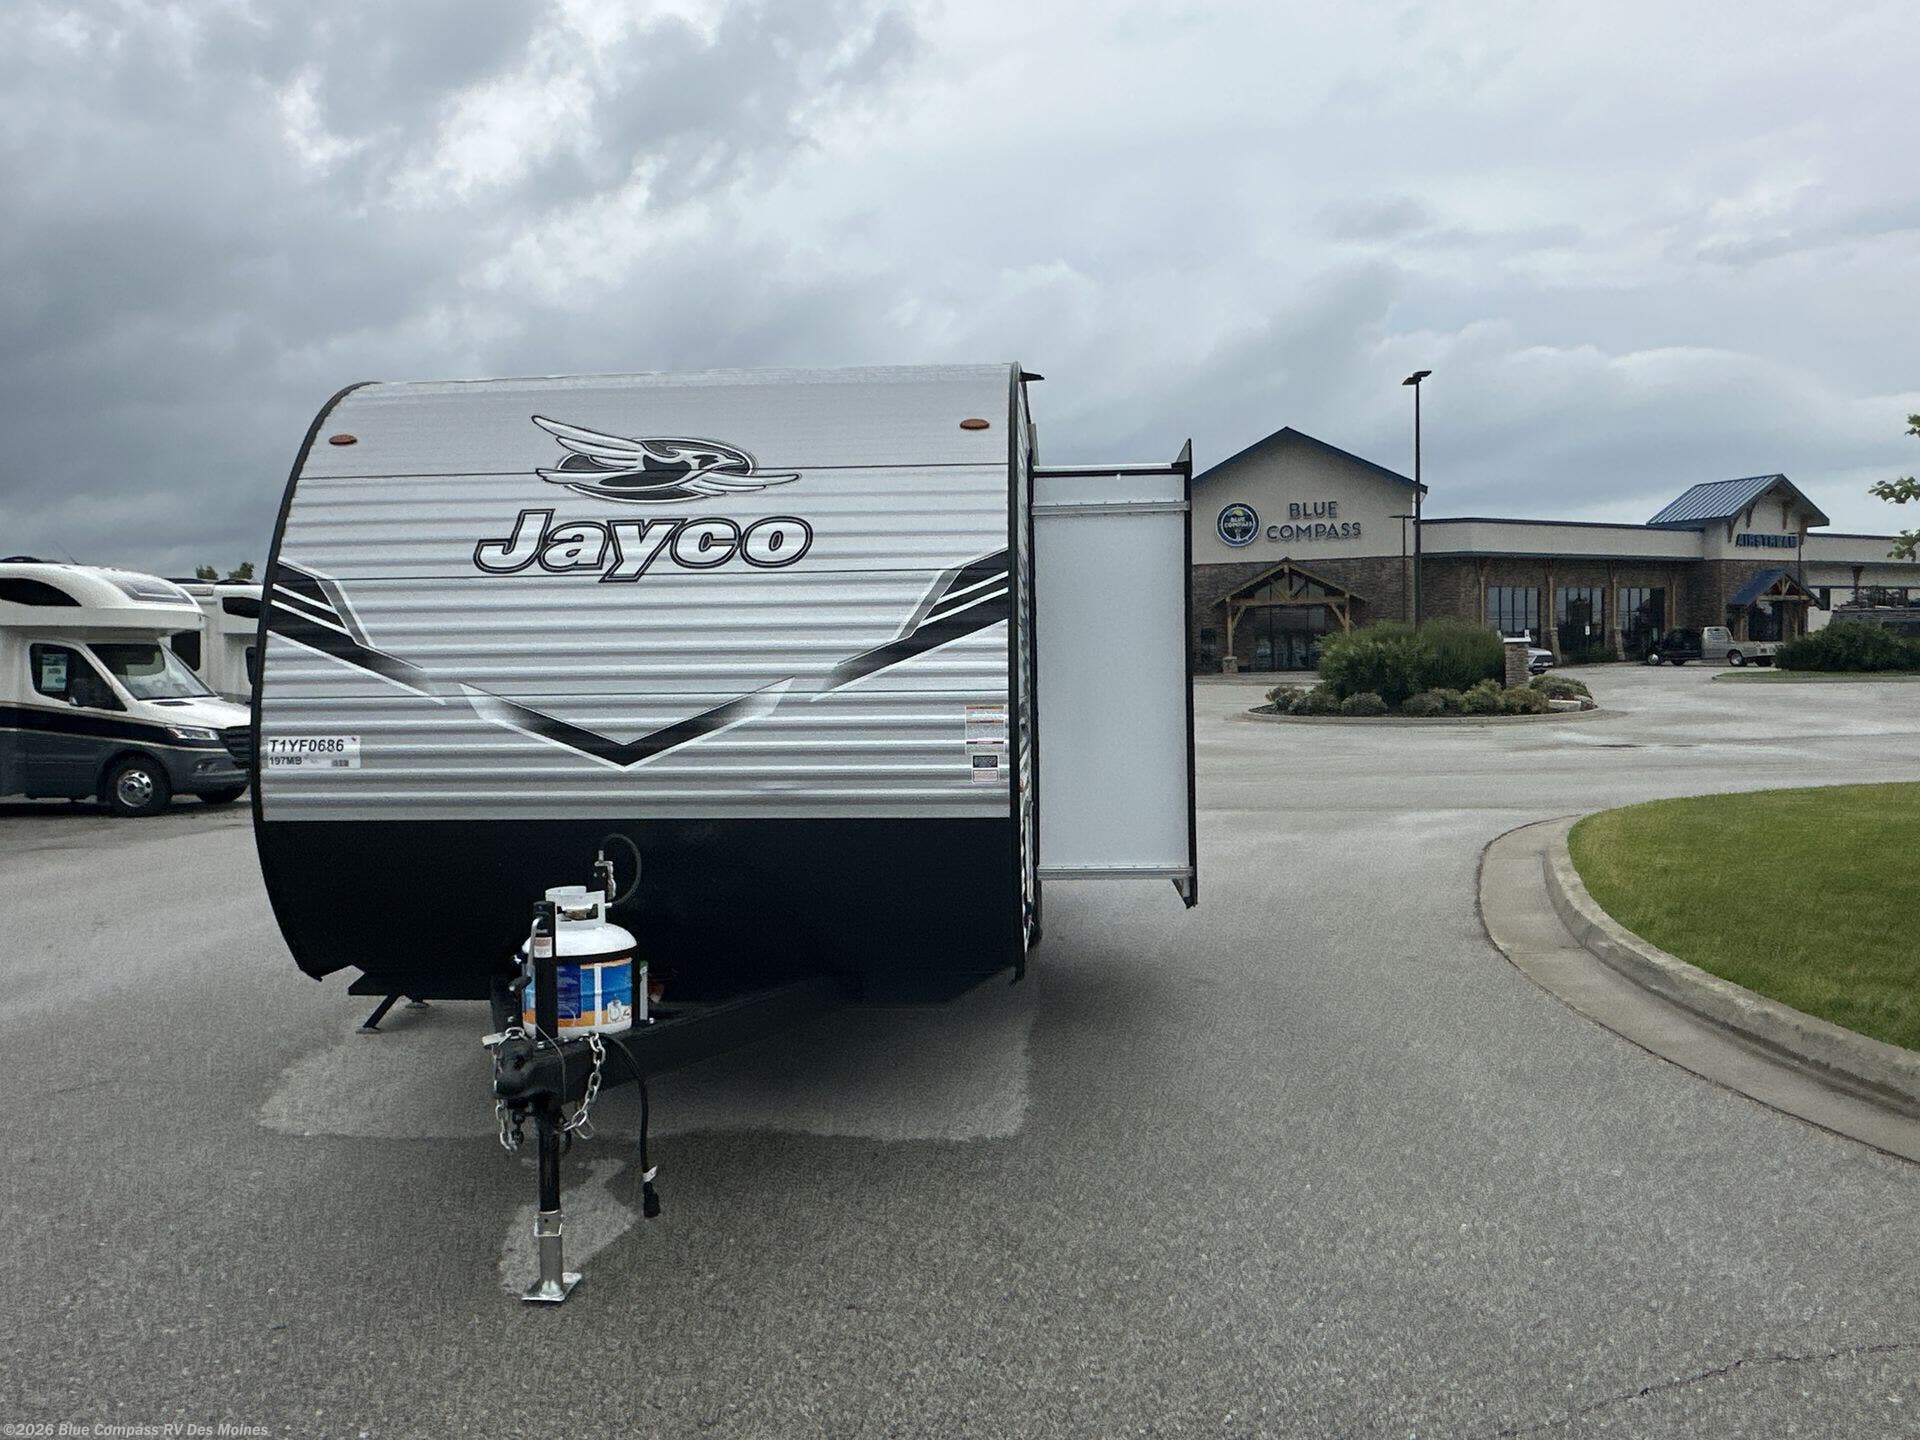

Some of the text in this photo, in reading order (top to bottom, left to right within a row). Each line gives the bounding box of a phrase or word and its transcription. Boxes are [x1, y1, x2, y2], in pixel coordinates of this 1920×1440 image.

[1289, 501, 1338, 519] BLUE
[1266, 522, 1362, 541] COMPASS
[473, 508, 813, 583] Jayco
[269, 739, 345, 753] T1YF0686
